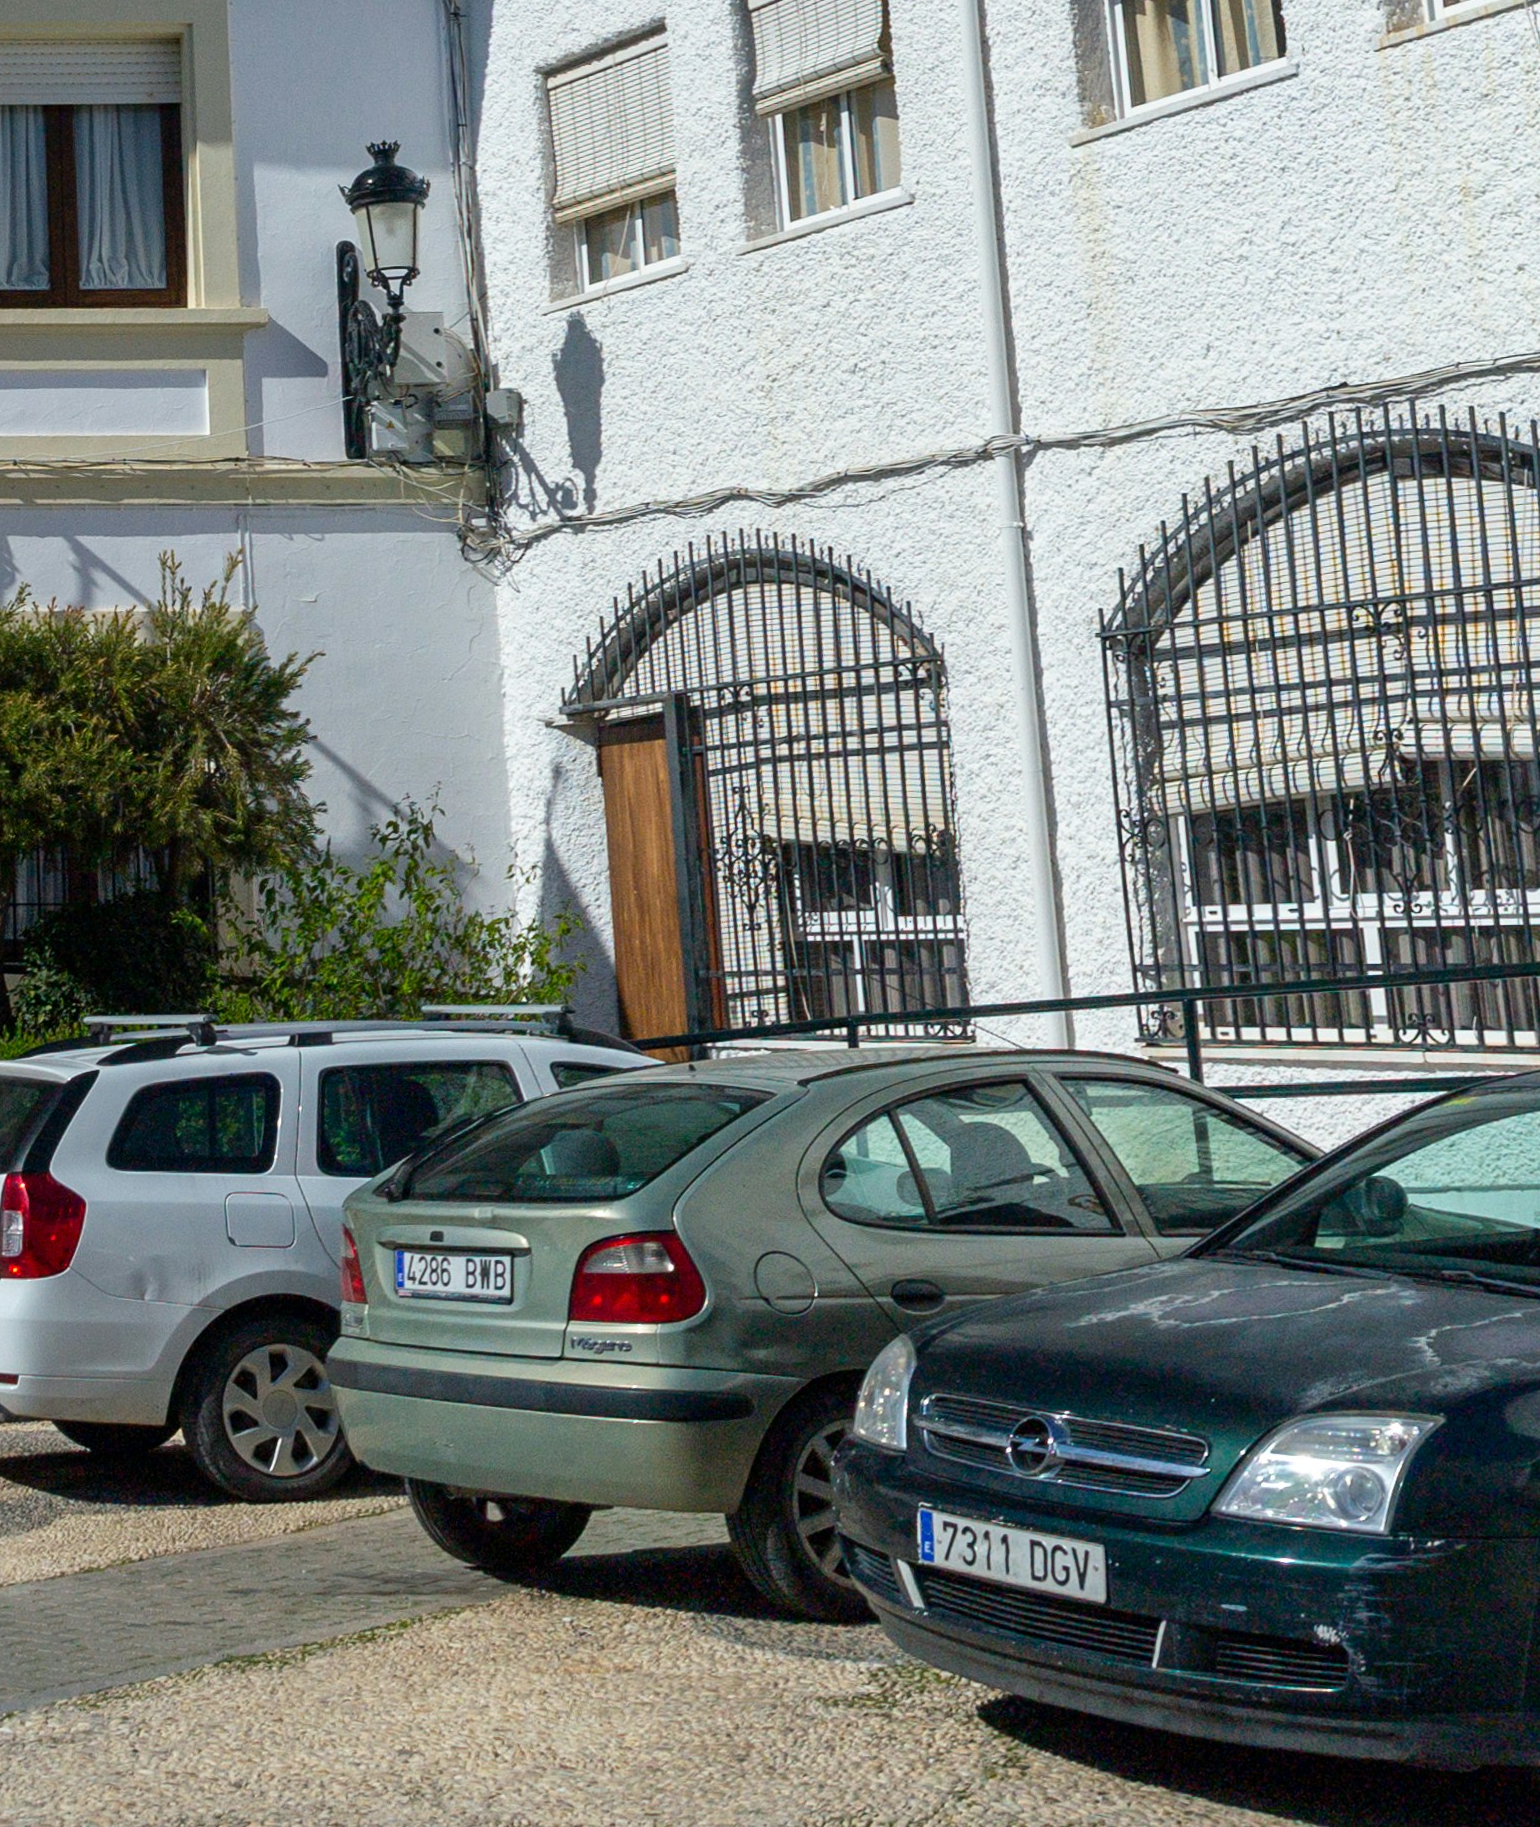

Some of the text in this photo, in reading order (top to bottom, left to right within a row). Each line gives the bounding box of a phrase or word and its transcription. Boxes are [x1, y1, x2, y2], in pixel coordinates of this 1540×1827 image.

[407, 1255, 451, 1287] 4286
[465, 1256, 507, 1291] BWB
[924, 1520, 1089, 1591] E 7311 DGV
